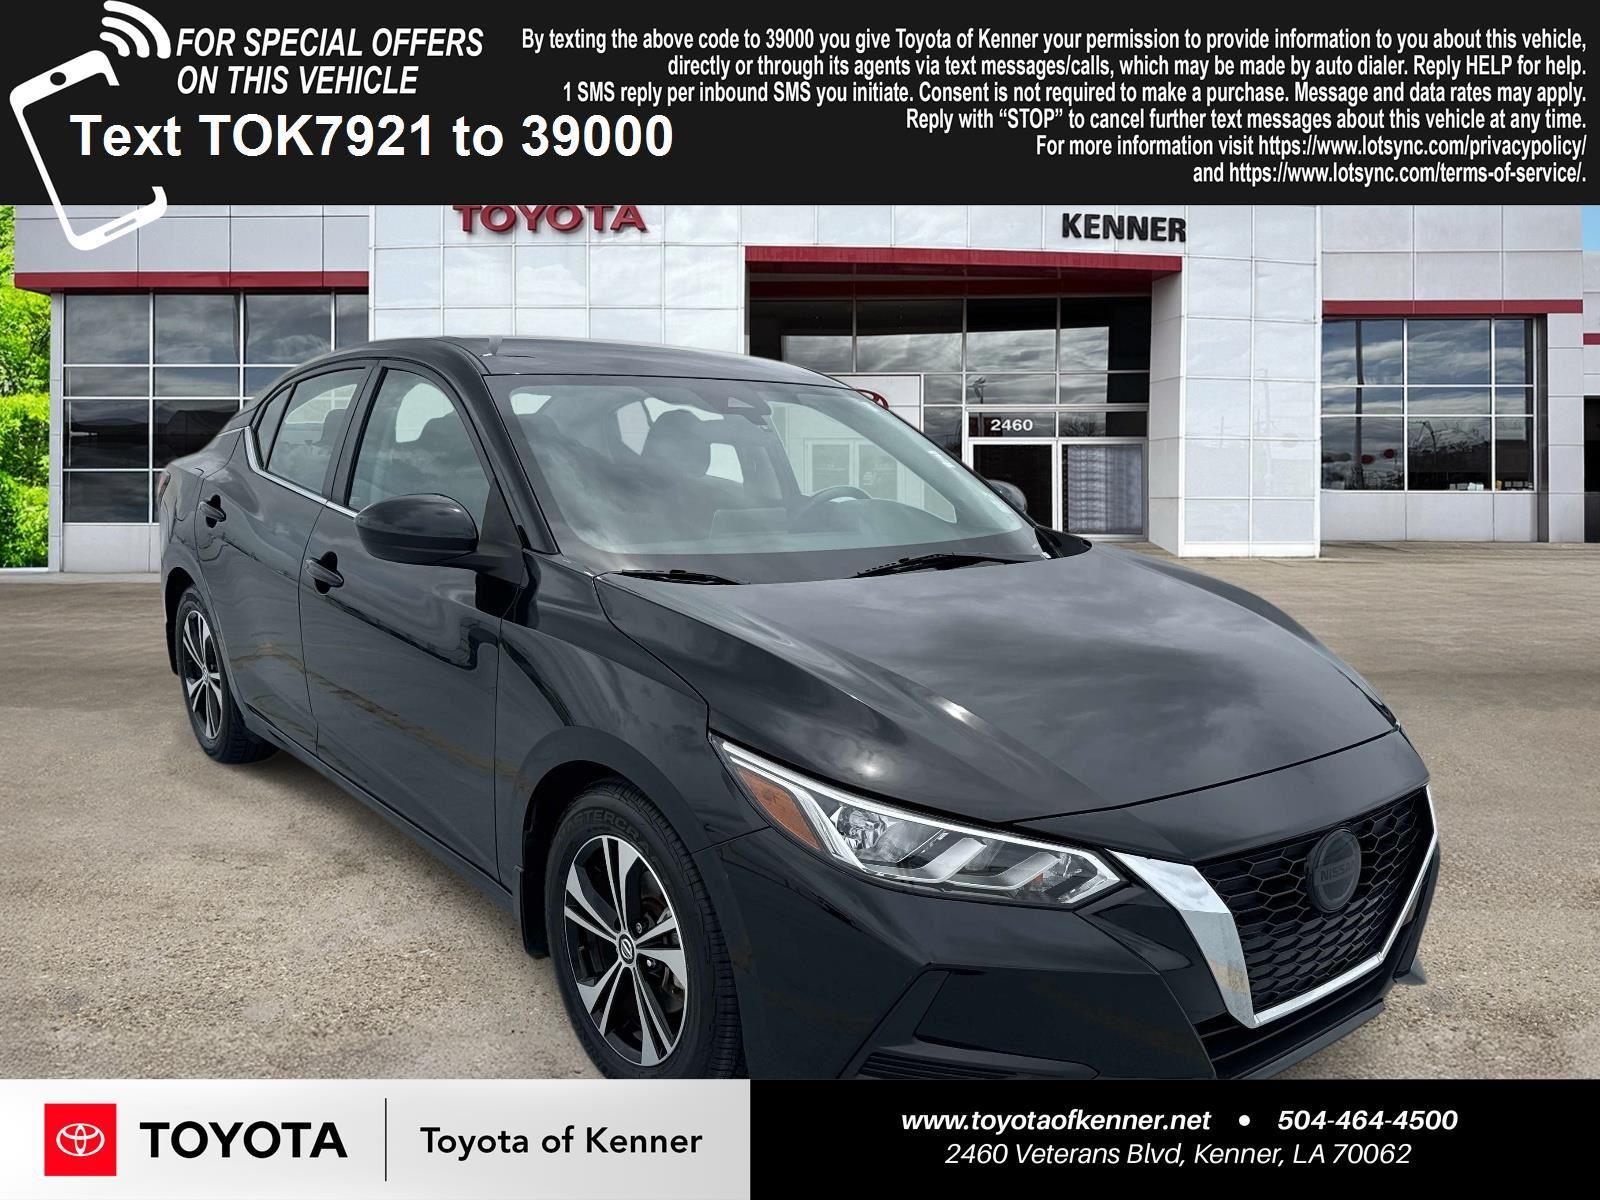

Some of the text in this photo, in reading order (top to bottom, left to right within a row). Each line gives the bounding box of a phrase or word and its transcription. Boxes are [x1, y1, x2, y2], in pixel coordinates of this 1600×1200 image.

[453, 205, 647, 232] TOYOTA
[1062, 212, 1187, 243] KENNER
[990, 418, 1034, 431] 2460
